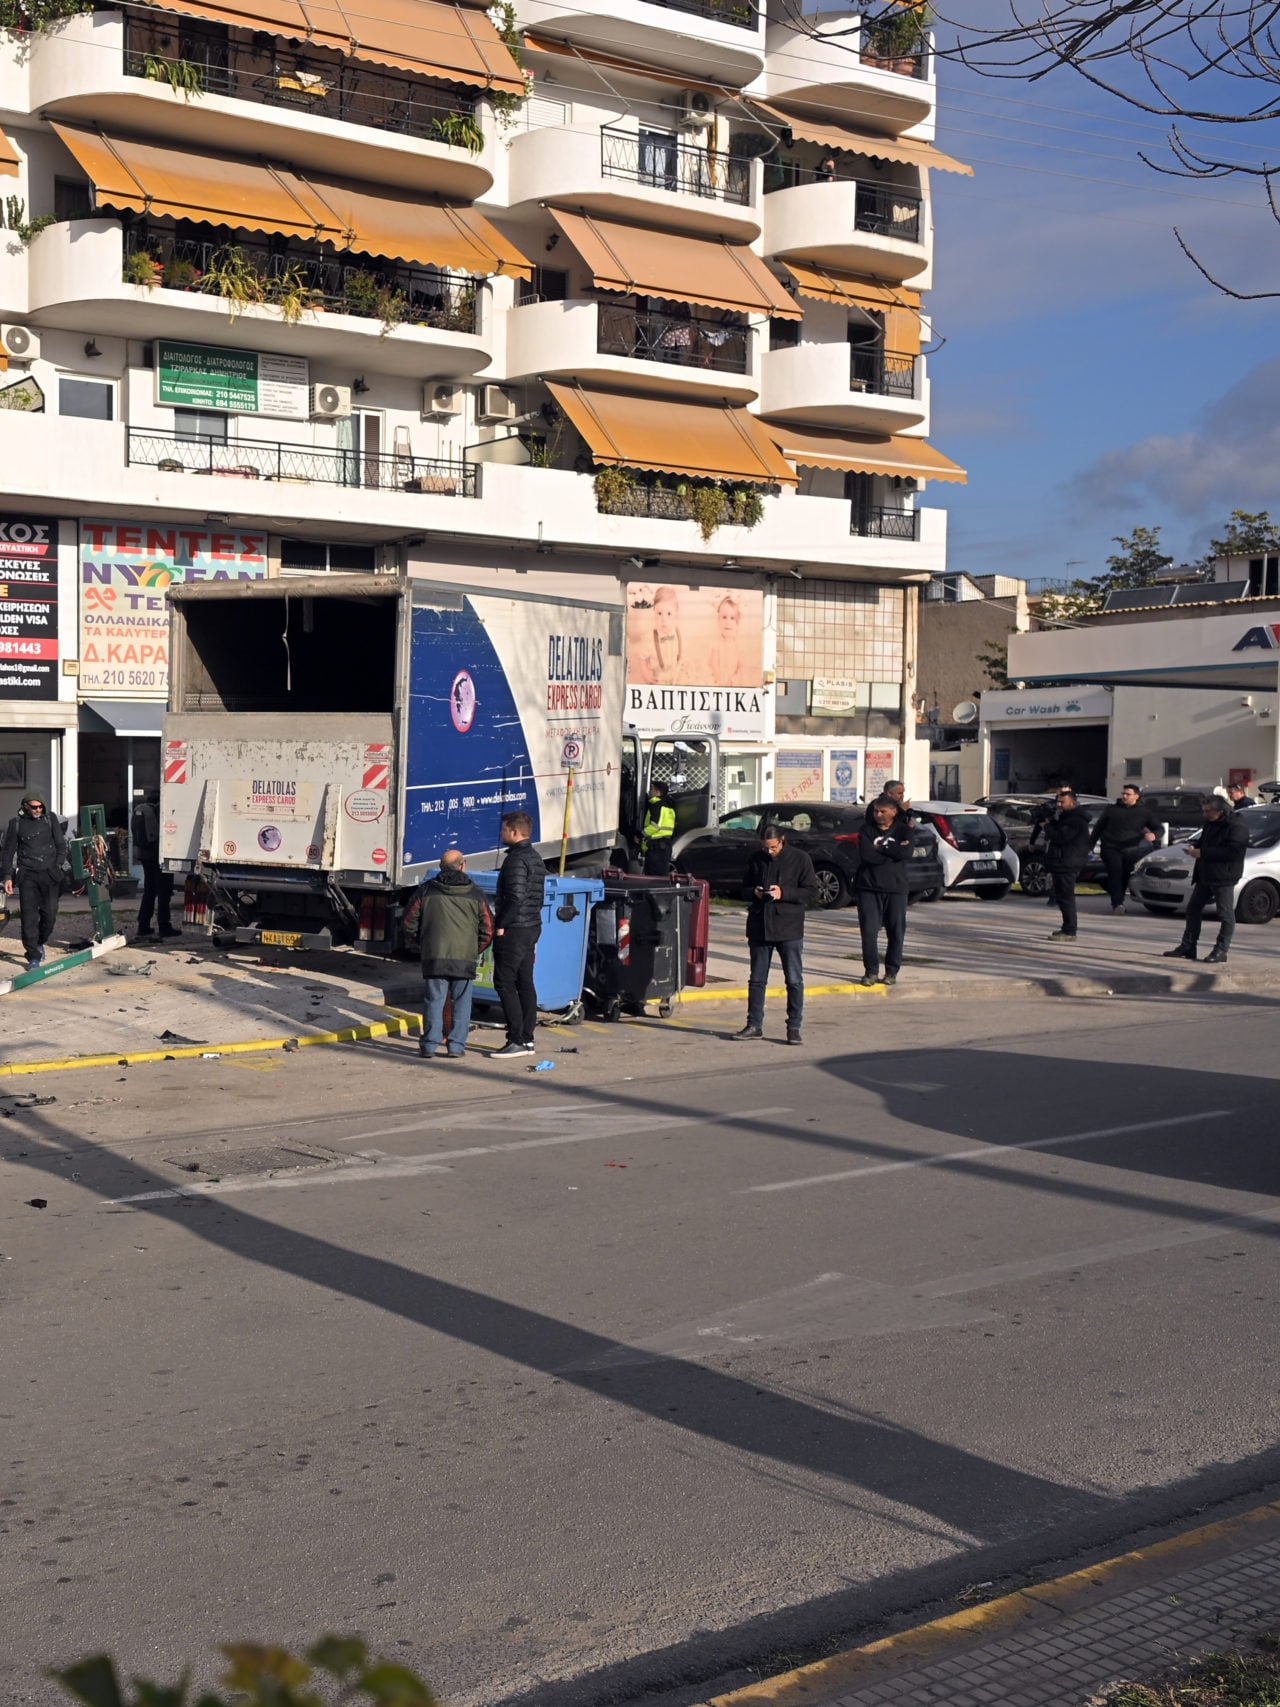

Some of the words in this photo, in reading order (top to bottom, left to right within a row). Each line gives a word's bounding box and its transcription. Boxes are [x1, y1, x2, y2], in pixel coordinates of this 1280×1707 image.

[163, 352, 202, 364] ΔΙΑΙΤΟΛΟΓΟΣ
[206, 357, 254, 371] ΔΙΑΤΡΟΦΟΛΟΓΟΣ
[216, 391, 228, 399] 210
[82, 523, 265, 563] ΤΕΝΤΕΣ
[25, 615, 48, 625] VISA
[84, 627, 102, 636] ΤΑ
[106, 628, 170, 639] ΚΑΛΥΤΕΡ
[548, 635, 603, 681] DELATOLAS
[83, 674, 102, 685] ΤΗΛ.
[103, 670, 125, 685] 210
[128, 671, 155, 686] 5620
[547, 684, 578, 711] EXPRESS
[579, 684, 602, 710] CARGO
[631, 688, 761, 713] ΒΑΠΤΙΣΤΙΚΑ
[1005, 705, 1027, 716] Car
[1029, 704, 1060, 714] Wash
[252, 780, 296, 796] DELATOLAS
[251, 795, 276, 804] EXPRESS
[276, 796, 296, 805] CARGO
[434, 800, 445, 812] 213
[462, 796, 475, 809] 9800
[226, 843, 235, 853] 70
